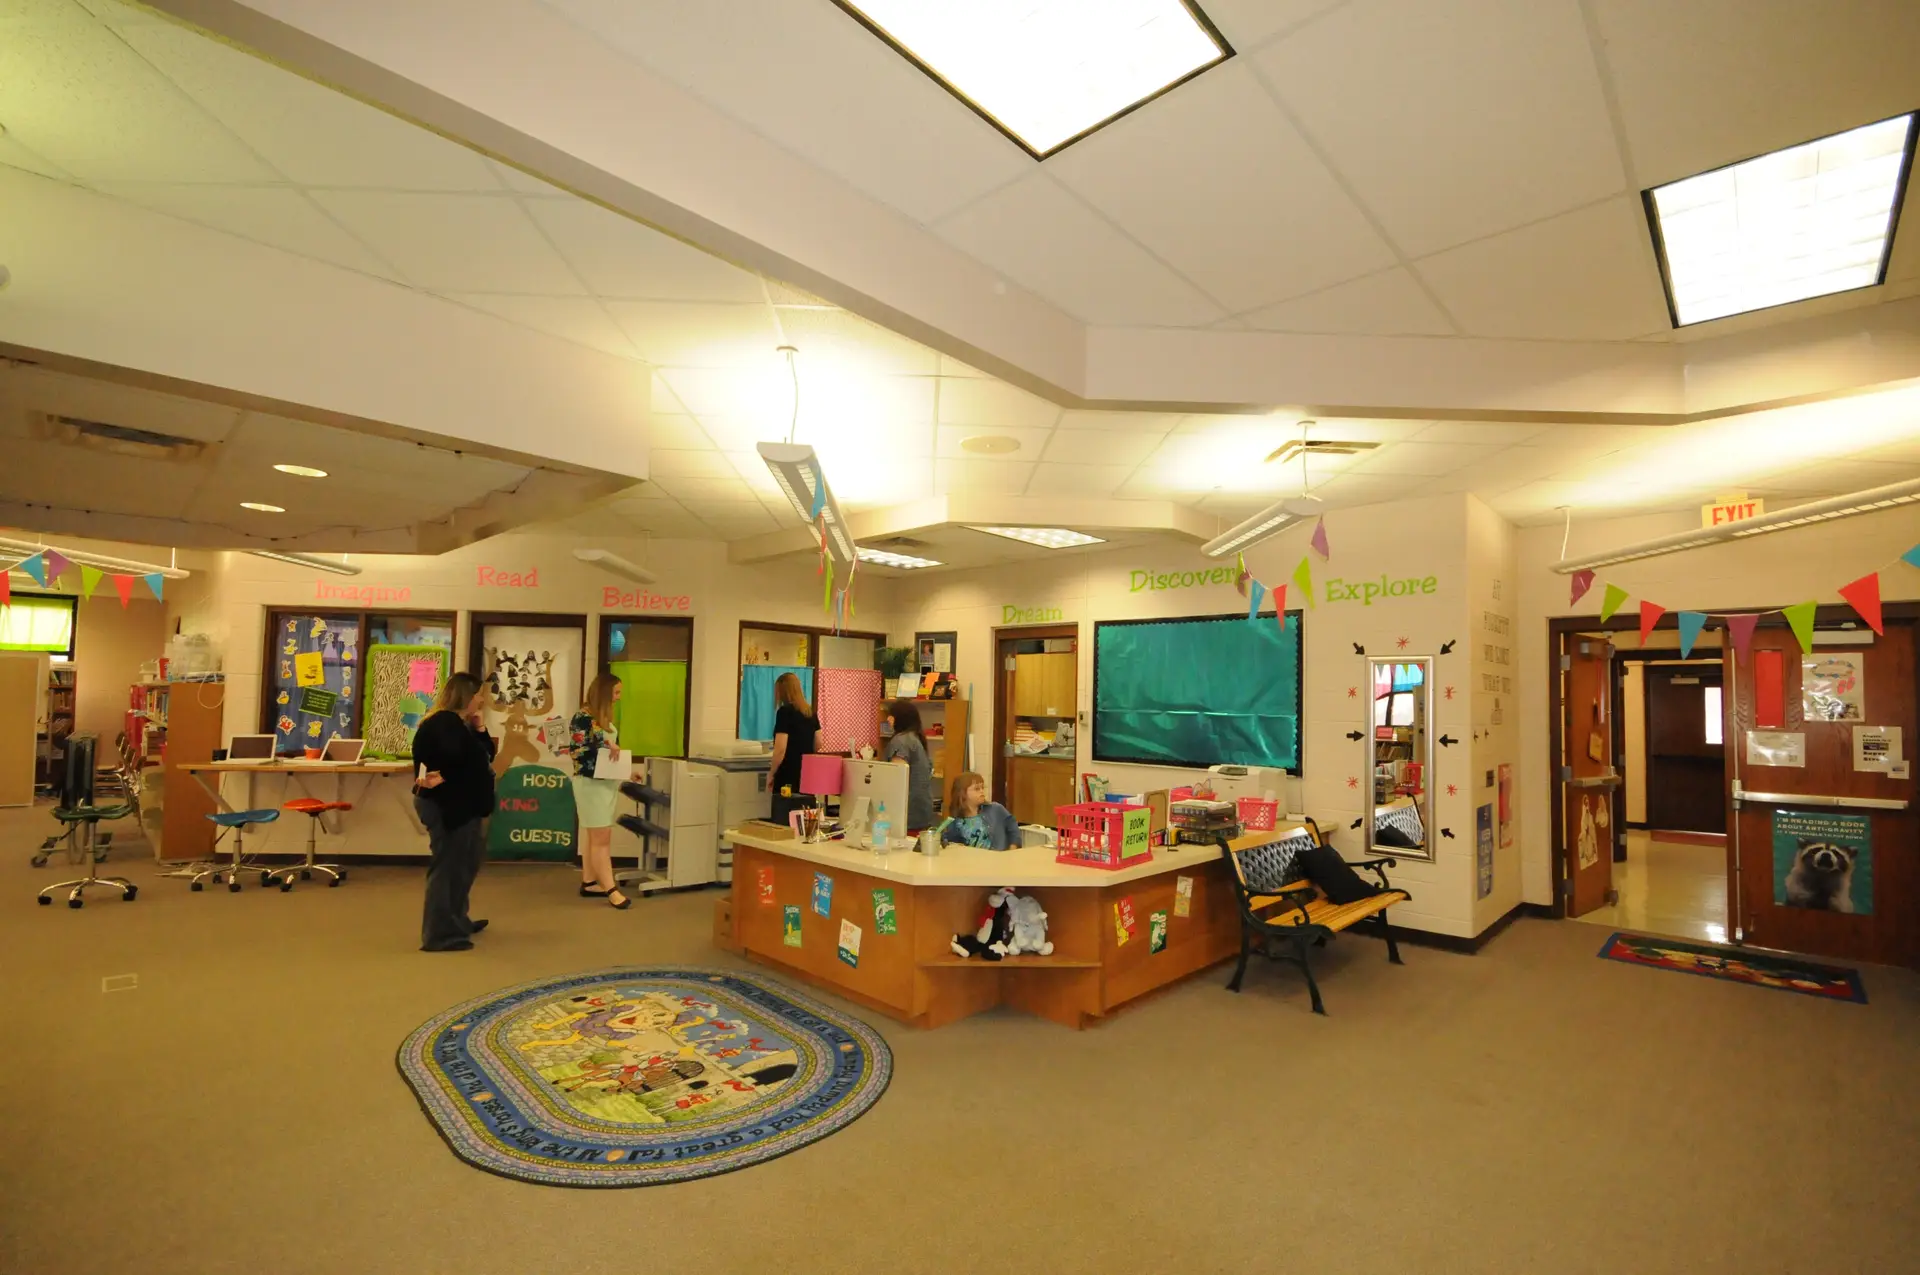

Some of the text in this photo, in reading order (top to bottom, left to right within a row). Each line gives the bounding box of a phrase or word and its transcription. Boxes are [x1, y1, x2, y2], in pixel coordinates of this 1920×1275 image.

[476, 565, 540, 588] Read
[1128, 565, 1237, 593] Discover
[314, 579, 411, 608] Imagine
[602, 586, 692, 610] Believe
[1325, 573, 1438, 606] Explore
[1002, 604, 1064, 624] Dream
[522, 773, 567, 789] HOST
[1129, 817, 1145, 830] BOOK
[1790, 818, 1830, 826] READING
[1805, 825, 1864, 834] ANTI-GRAVITY
[509, 828, 572, 847] GUESTS
[1126, 832, 1148, 846] RETURN
[768, 1110, 807, 1132] had
[749, 1127, 765, 1138] a
[672, 1130, 745, 1159] great
[628, 1148, 666, 1161] fall
